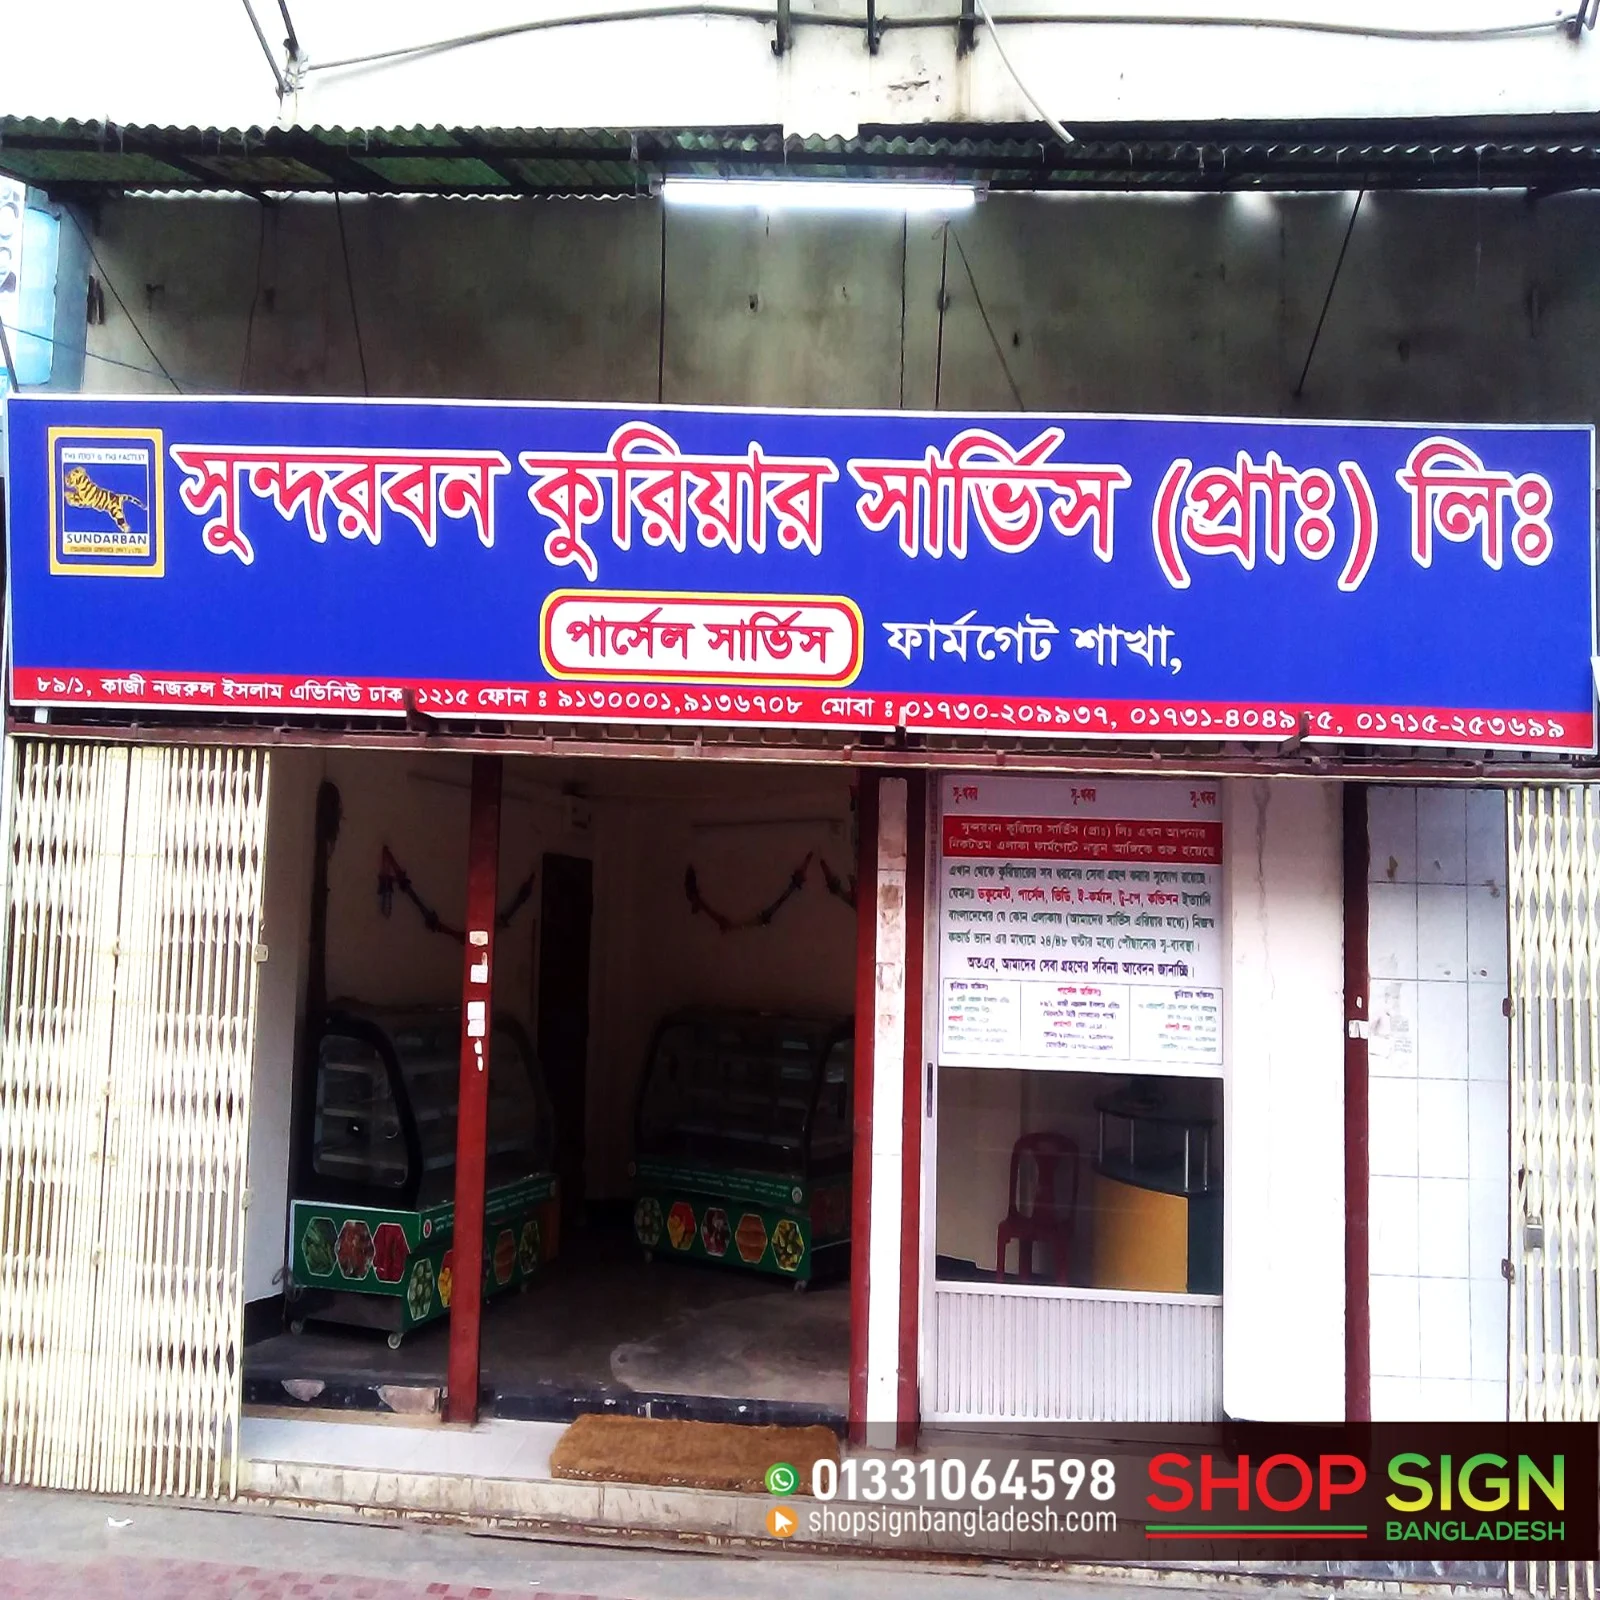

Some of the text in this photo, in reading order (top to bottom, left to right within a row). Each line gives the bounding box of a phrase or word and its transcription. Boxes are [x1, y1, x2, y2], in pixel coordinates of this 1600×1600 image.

[169, 421, 1554, 592] সুন্দরবন কুরিয়ার সার্ভিস (প্রাঃ) লিঃ
[66, 534, 147, 545] SUNDARBAN
[567, 607, 833, 664] পার্সেল সার্ভিস
[882, 610, 1059, 664] ফার্মগেট
[100, 672, 146, 696] কাজী
[151, 679, 216, 699] নজরুল
[221, 677, 283, 701] ইসলাম
[368, 686, 411, 703] ঢাক
[418, 687, 469, 705] ১২১৫
[478, 687, 529, 707] ফোন
[821, 697, 876, 718] মোবা
[1356, 711, 1565, 738] ০১৭১৫-২৫৩৬৯৯
